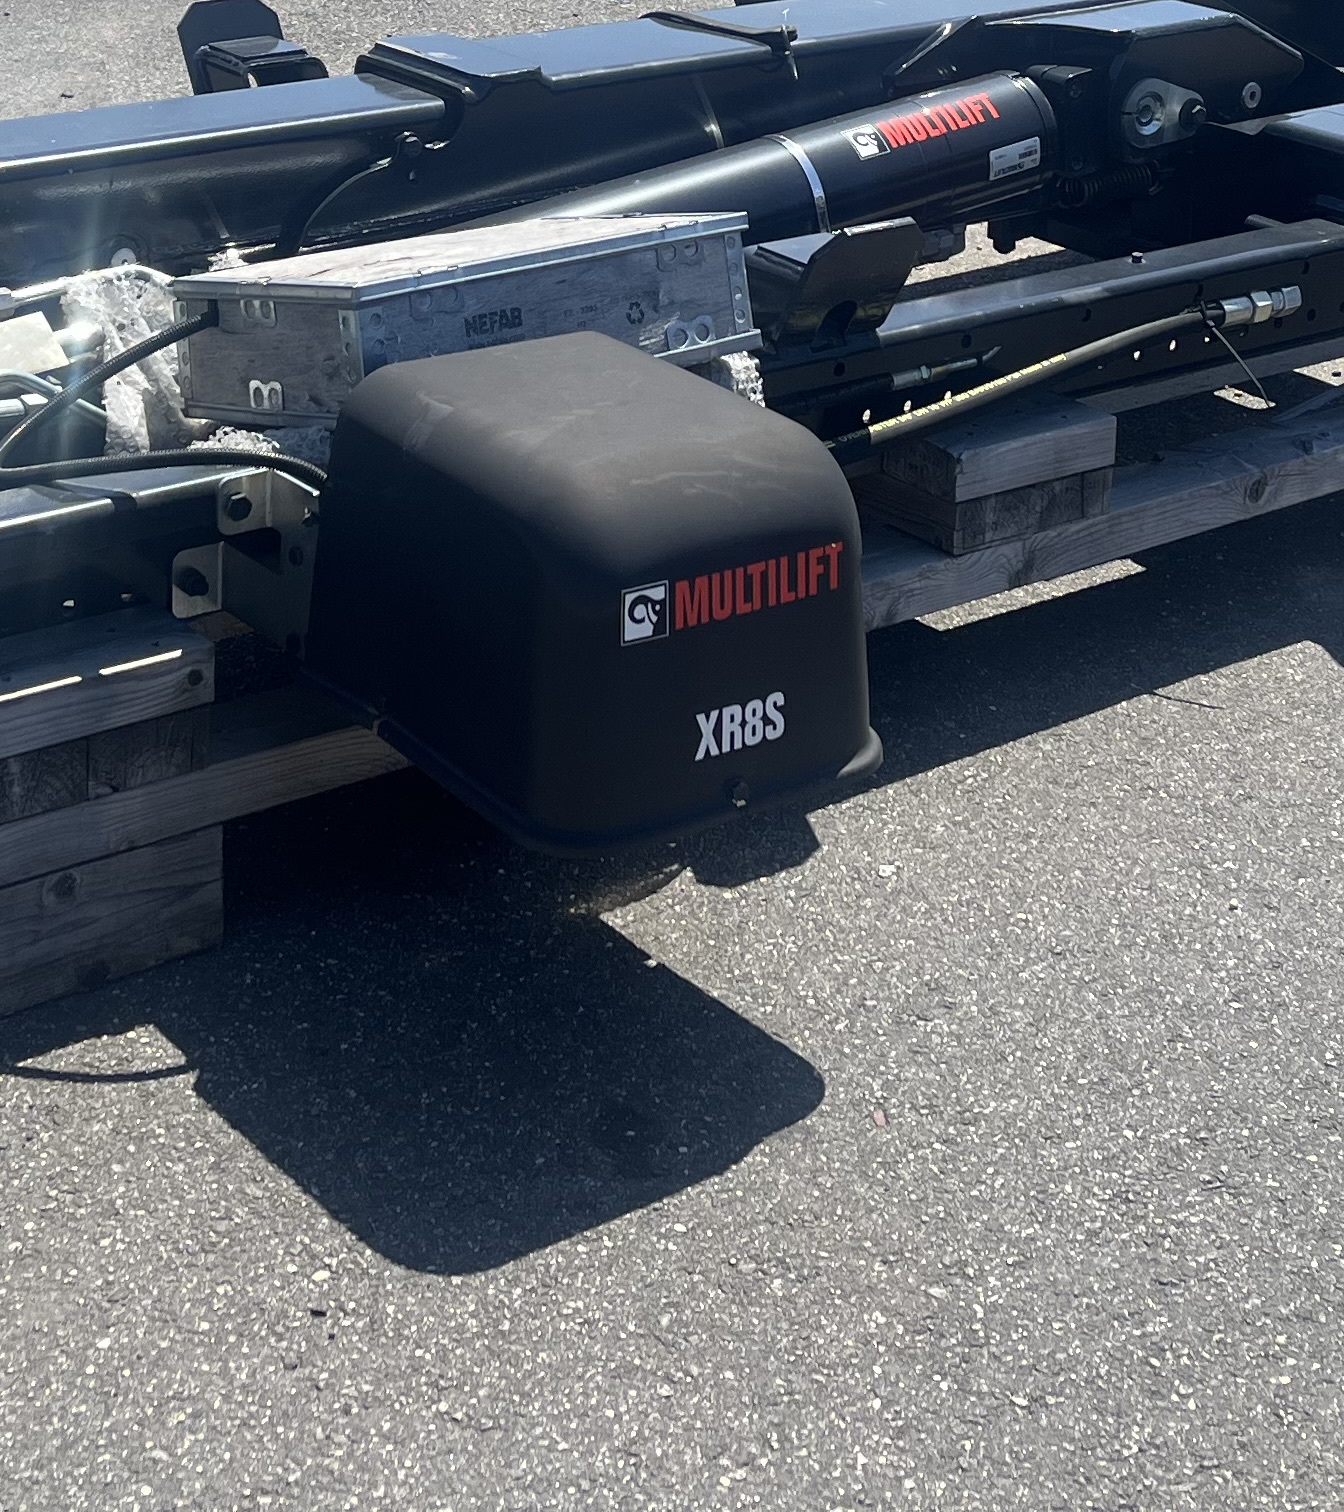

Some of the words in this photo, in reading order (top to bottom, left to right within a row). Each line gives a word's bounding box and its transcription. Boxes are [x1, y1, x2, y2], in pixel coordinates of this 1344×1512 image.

[876, 92, 1001, 149] MULTILIFT
[463, 307, 524, 338] NEFAB
[674, 541, 844, 631] MULTILIFT
[694, 691, 786, 762] XR8S
